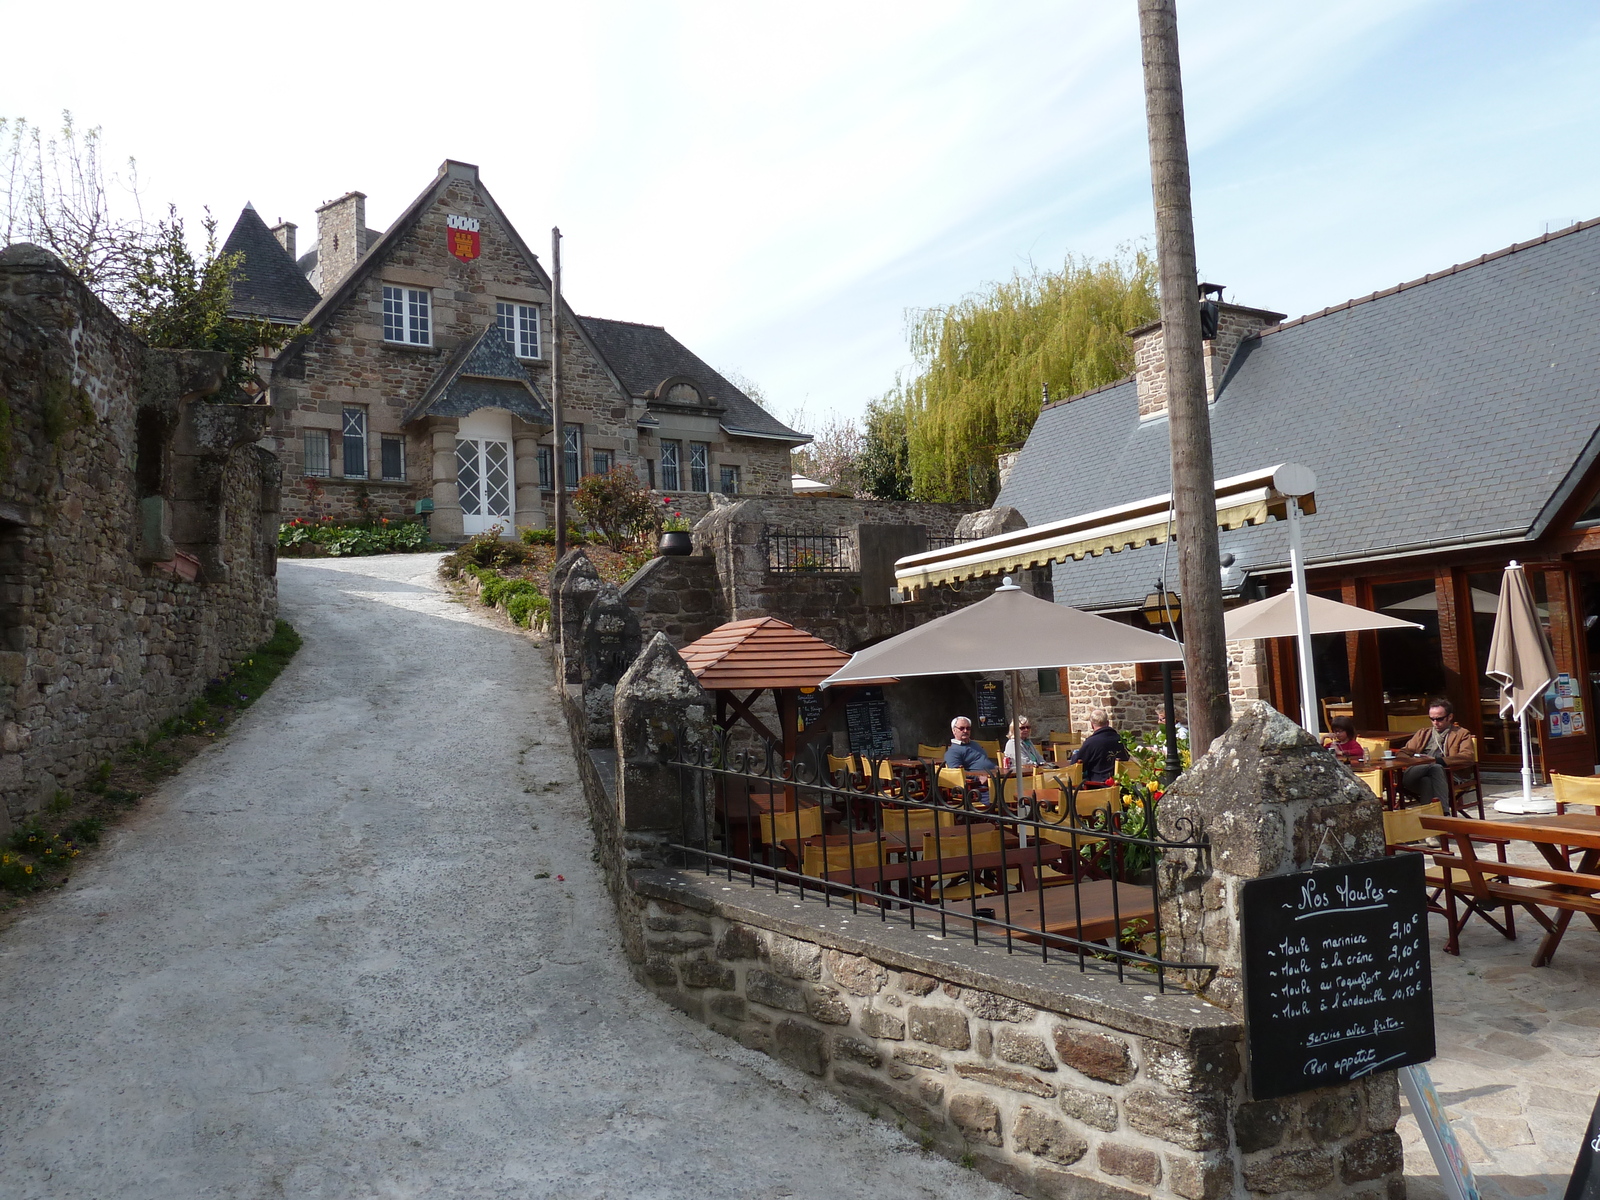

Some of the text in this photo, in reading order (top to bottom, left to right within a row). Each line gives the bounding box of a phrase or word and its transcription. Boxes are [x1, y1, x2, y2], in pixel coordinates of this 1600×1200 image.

[1297, 874, 1384, 909] Nos Moules
[1331, 951, 1343, 967] la
[1320, 981, 1332, 990] au
[1336, 970, 1382, 991] roquefort
[1346, 1023, 1366, 1037] avec
[1303, 1058, 1328, 1075] Bon
